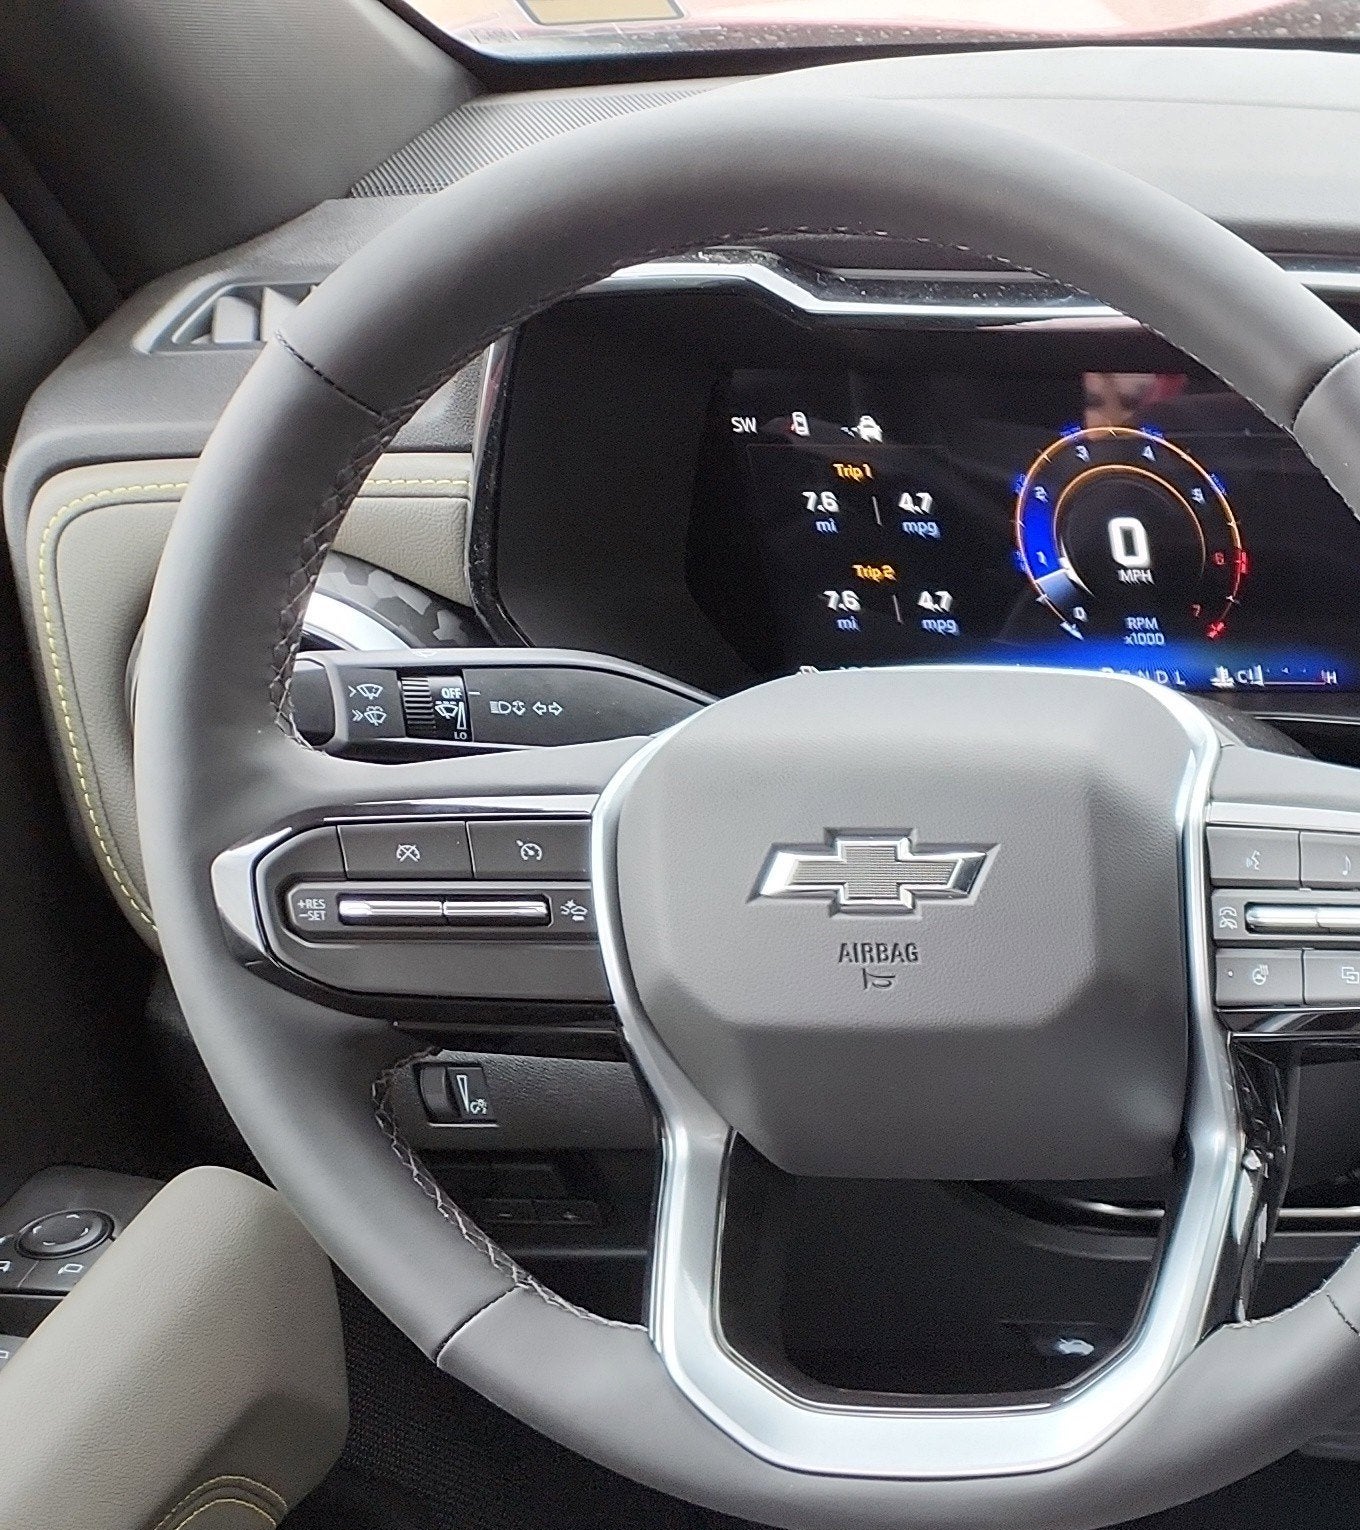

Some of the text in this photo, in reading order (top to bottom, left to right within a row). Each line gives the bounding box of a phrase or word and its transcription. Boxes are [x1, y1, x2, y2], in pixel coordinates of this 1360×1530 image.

[731, 416, 758, 434] SW
[832, 463, 874, 482] Trip 1
[802, 491, 839, 513] 7.6
[898, 492, 933, 514] 4.7
[815, 518, 839, 533] mi
[902, 520, 941, 539] mpg
[1108, 517, 1151, 568] 0
[852, 564, 897, 583] Trip 2
[1118, 569, 1154, 585] MPH
[823, 590, 862, 612] 7.6
[917, 591, 954, 613] 4.7
[836, 616, 861, 632] mi
[921, 618, 961, 637] mpg
[1126, 617, 1159, 631] RPM
[1124, 632, 1165, 646] x1000
[441, 688, 463, 699] OFF
[454, 731, 468, 741] LO
[838, 942, 919, 963] AIRBAG
